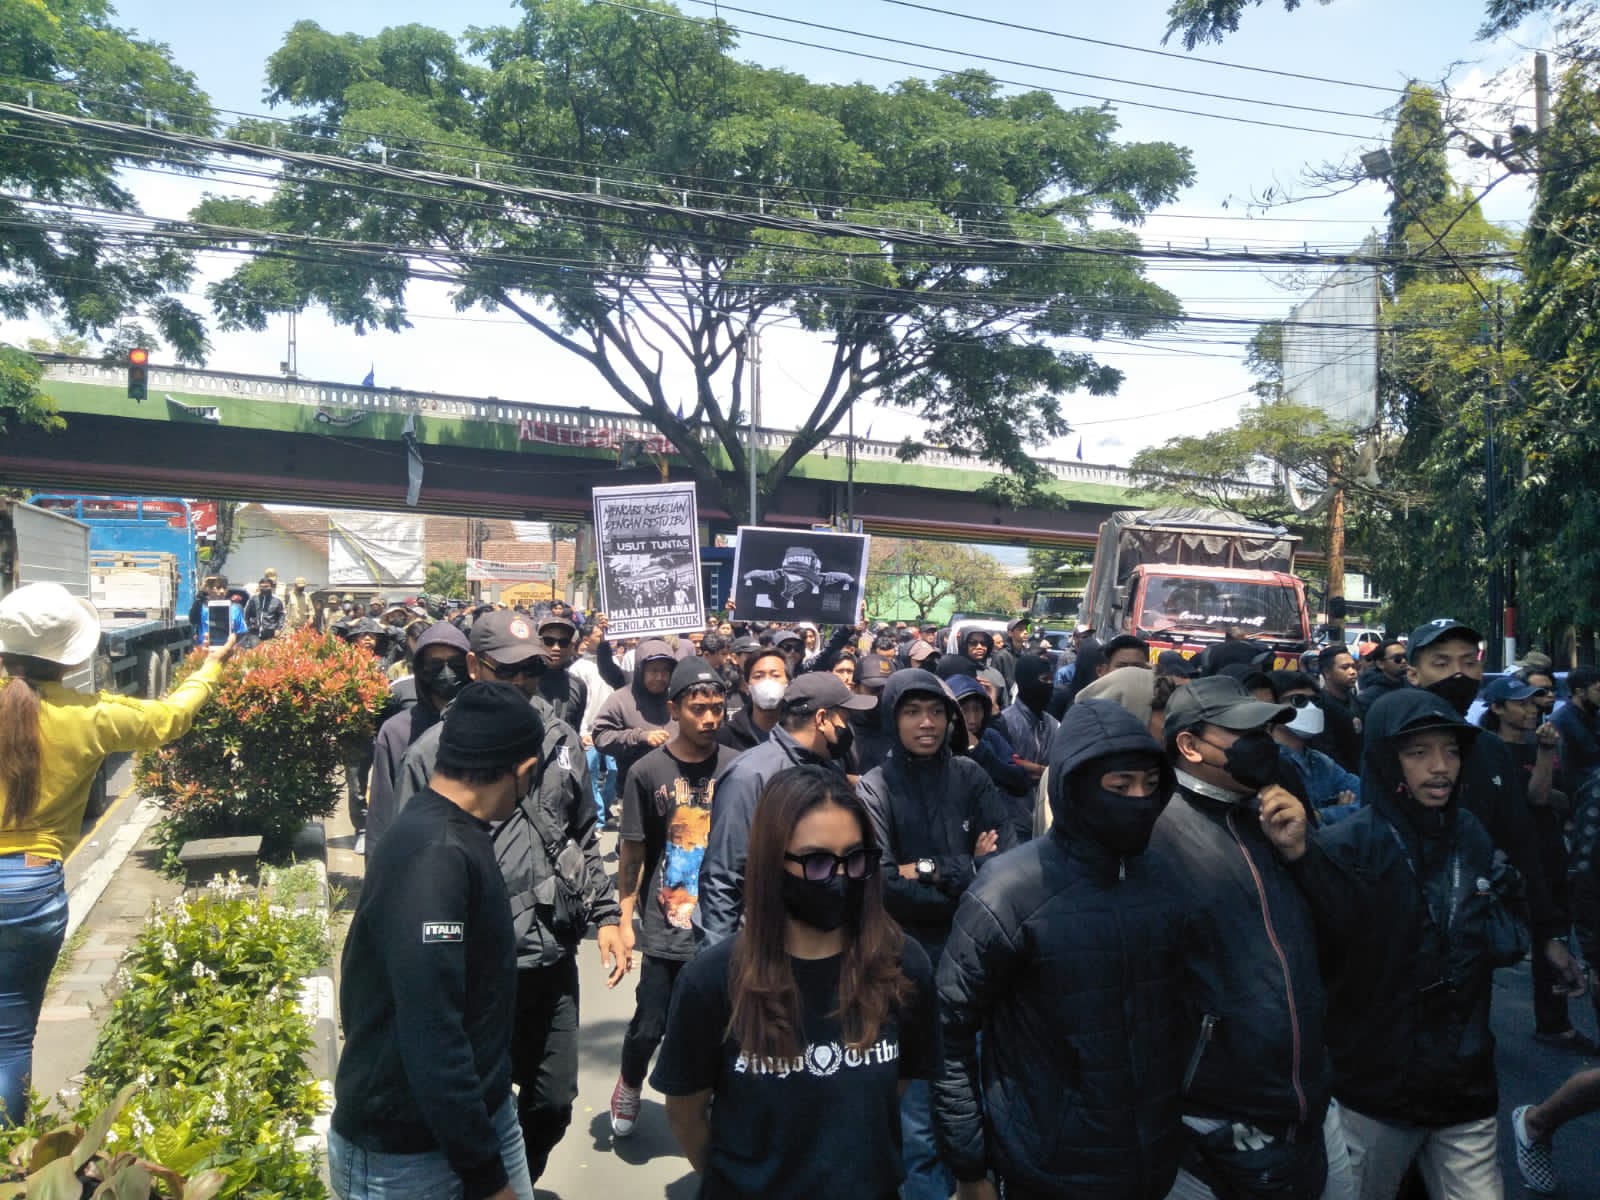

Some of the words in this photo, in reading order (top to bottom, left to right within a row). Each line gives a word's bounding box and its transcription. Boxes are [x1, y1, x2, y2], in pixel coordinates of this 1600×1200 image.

[616, 541, 646, 551] USUT
[649, 539, 690, 550] TUNTAS
[610, 607, 650, 620] MALANG
[651, 603, 696, 616] MELAWAN
[608, 619, 656, 632] MENOLAK
[659, 615, 699, 628] TUNDUK
[425, 925, 461, 936] ITALIA
